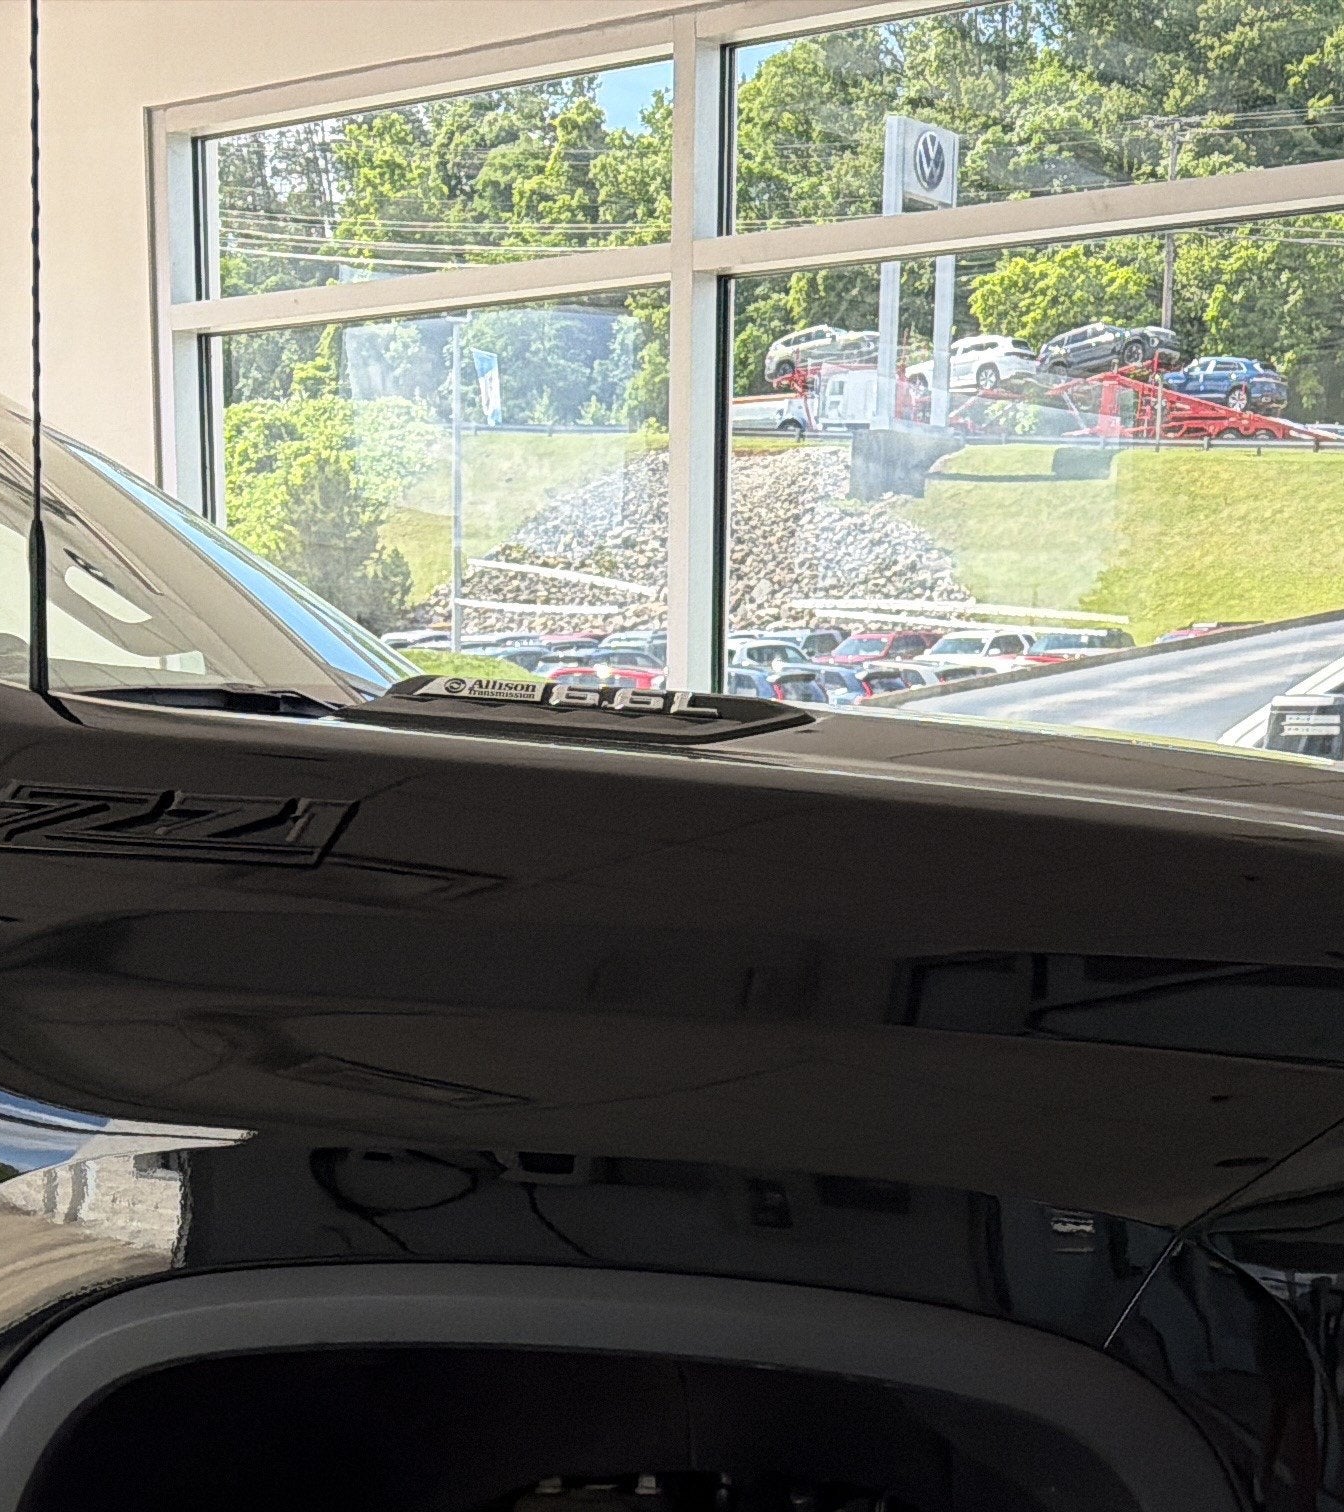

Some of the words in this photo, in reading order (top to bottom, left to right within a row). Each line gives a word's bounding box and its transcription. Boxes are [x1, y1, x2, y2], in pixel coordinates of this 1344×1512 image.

[469, 678, 537, 693] Allison
[467, 688, 536, 700] Transmission
[549, 684, 719, 718] 6.6L
